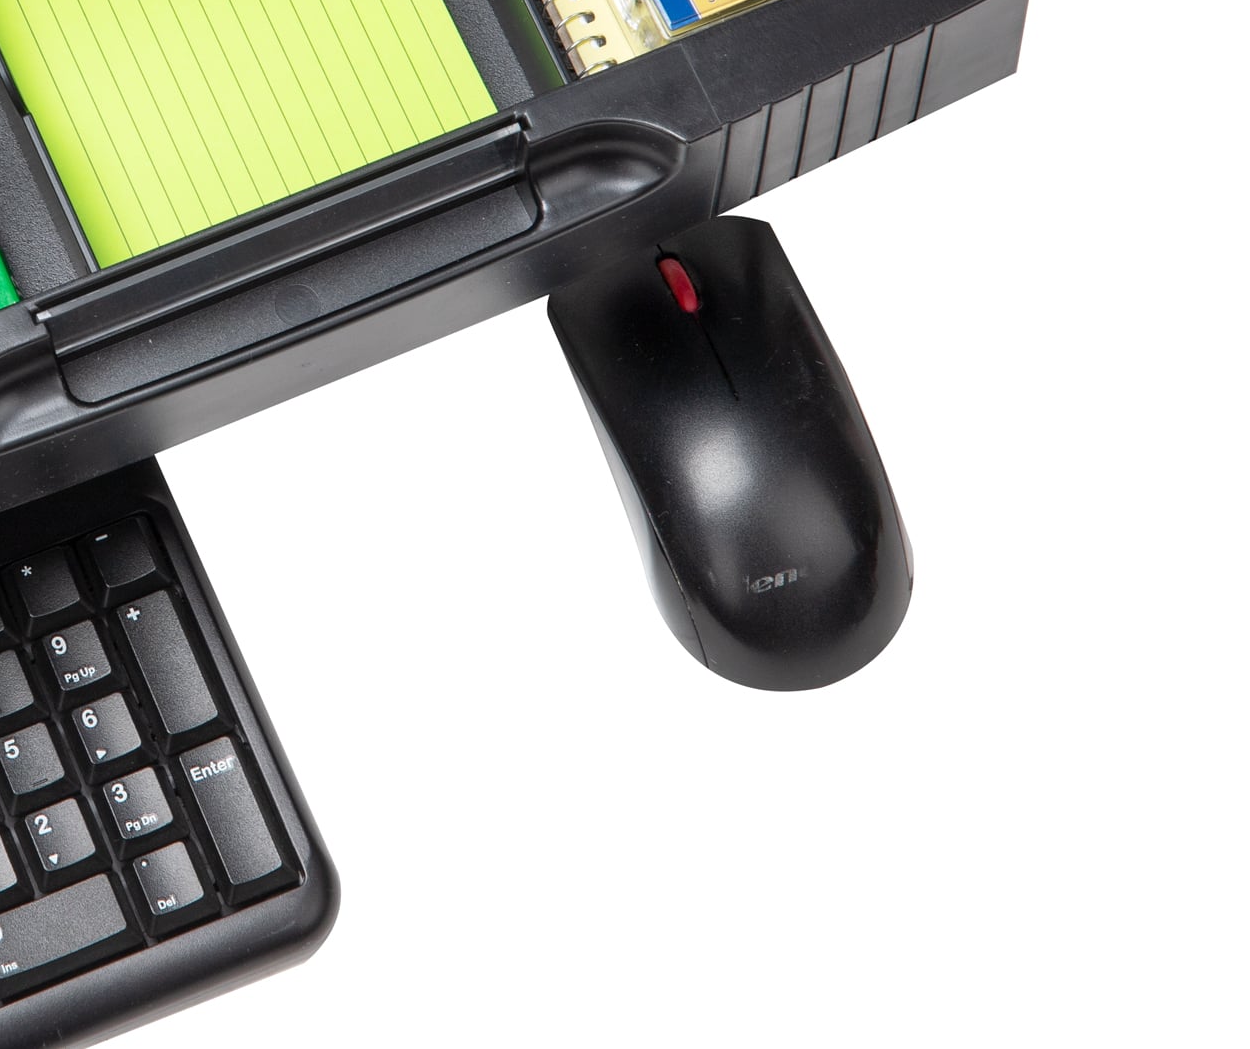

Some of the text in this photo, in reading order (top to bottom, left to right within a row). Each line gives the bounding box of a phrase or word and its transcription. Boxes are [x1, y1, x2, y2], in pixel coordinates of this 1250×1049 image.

[51, 636, 68, 656] 9
[63, 666, 96, 685] Pg Up
[80, 709, 98, 729] 6
[3, 739, 20, 759] 5
[189, 756, 236, 783] Enter
[110, 783, 128, 803] 3
[34, 814, 52, 835] 2
[124, 812, 157, 833] Pg Dn
[157, 896, 177, 910] Del
[0, 960, 19, 975] Ins
